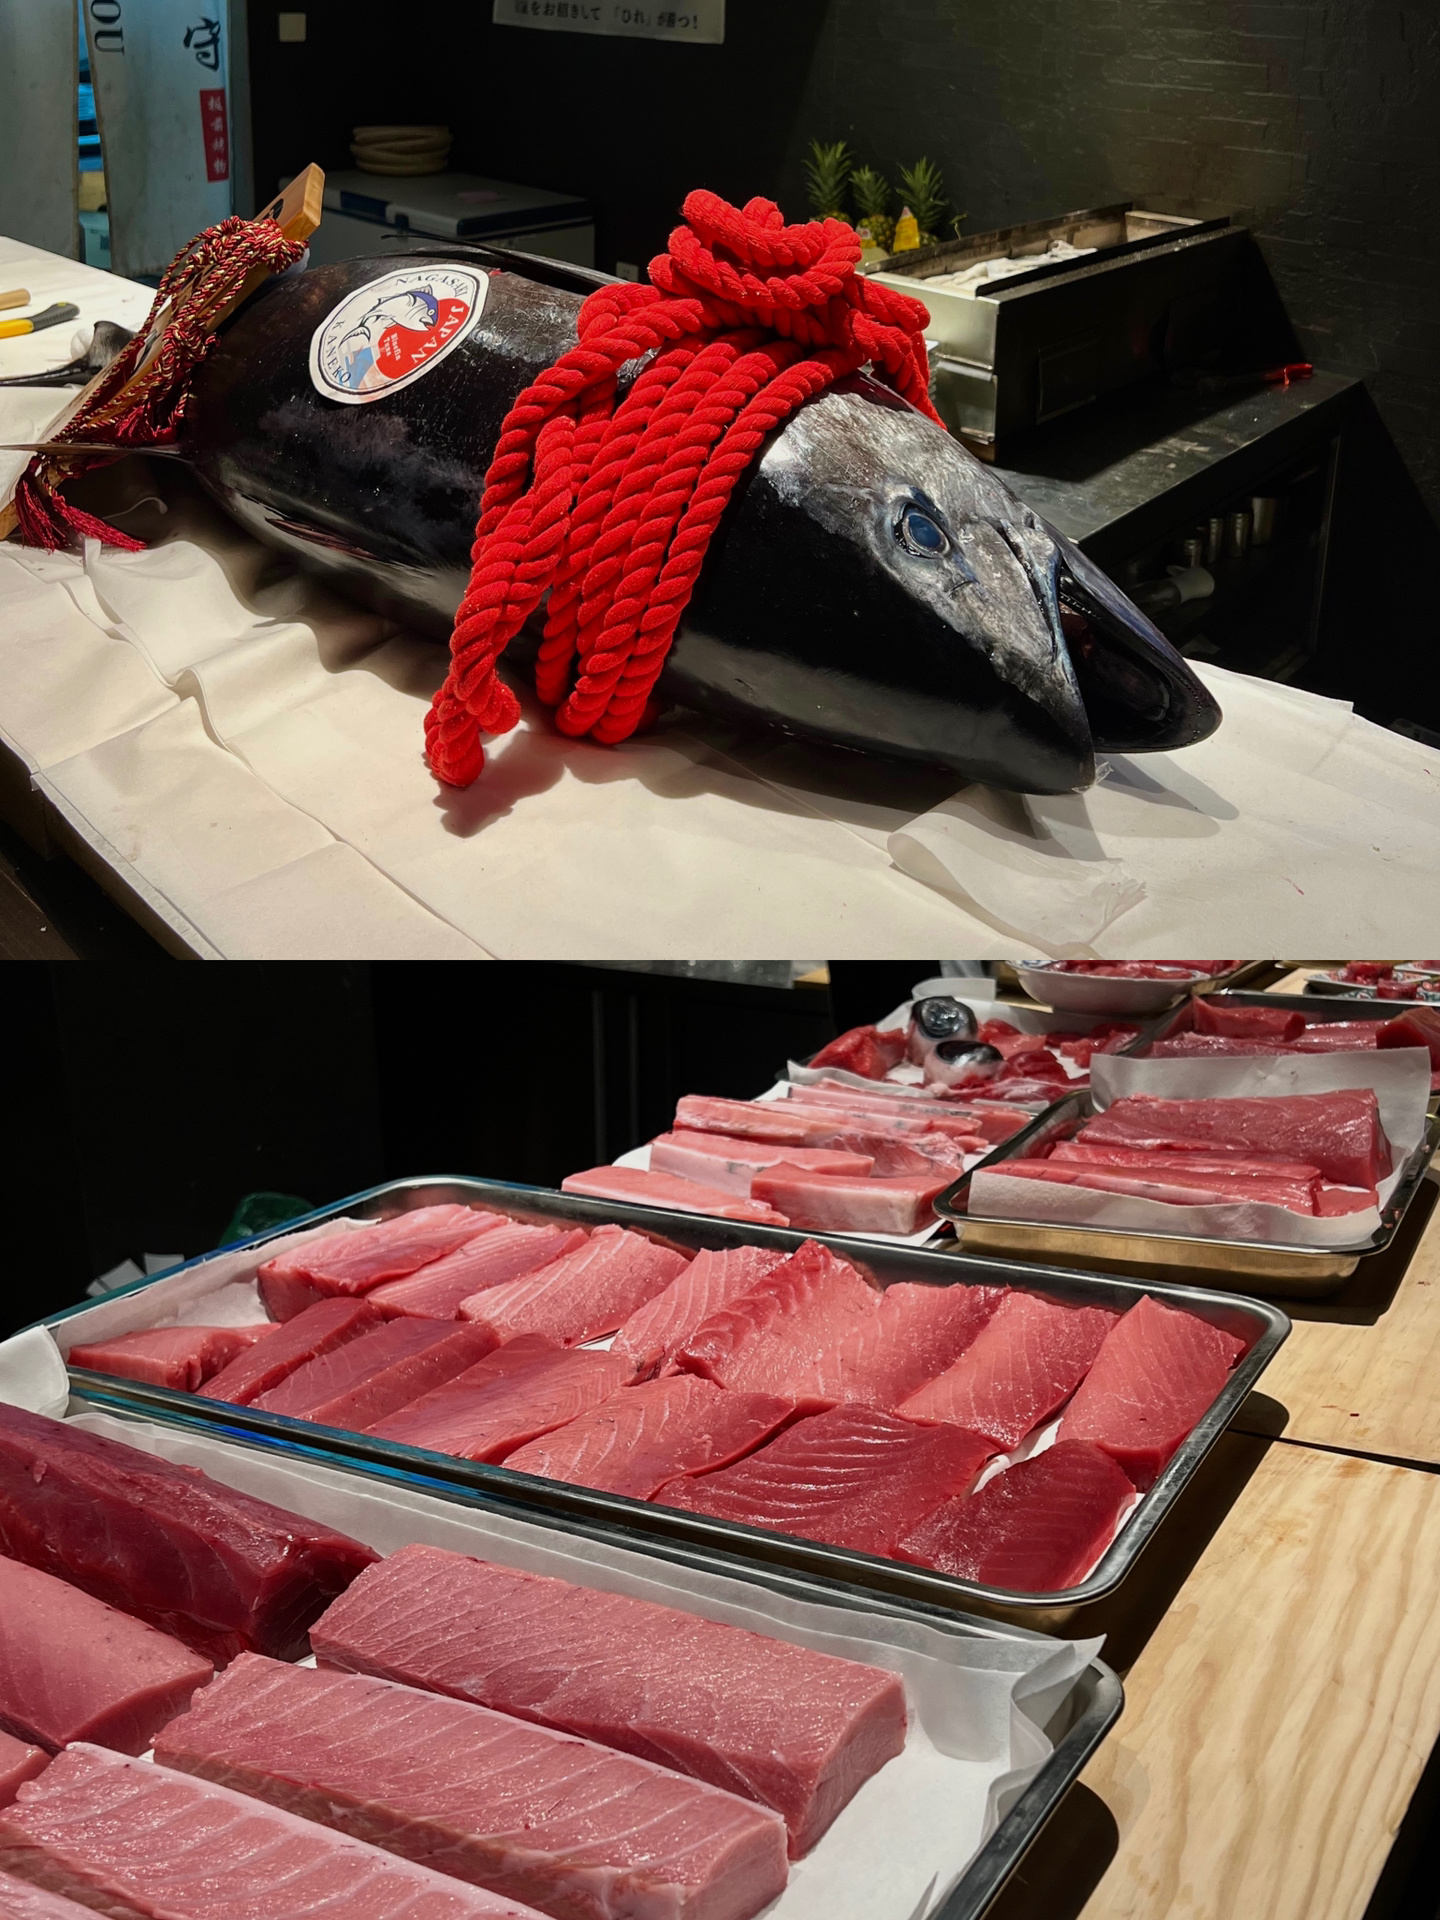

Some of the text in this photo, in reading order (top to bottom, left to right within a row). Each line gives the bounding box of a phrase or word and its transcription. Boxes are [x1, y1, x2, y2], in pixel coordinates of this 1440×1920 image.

[394, 272, 469, 298] NAGASAKI
[326, 319, 352, 384] KANEKO
[411, 304, 465, 365] JAPAN
